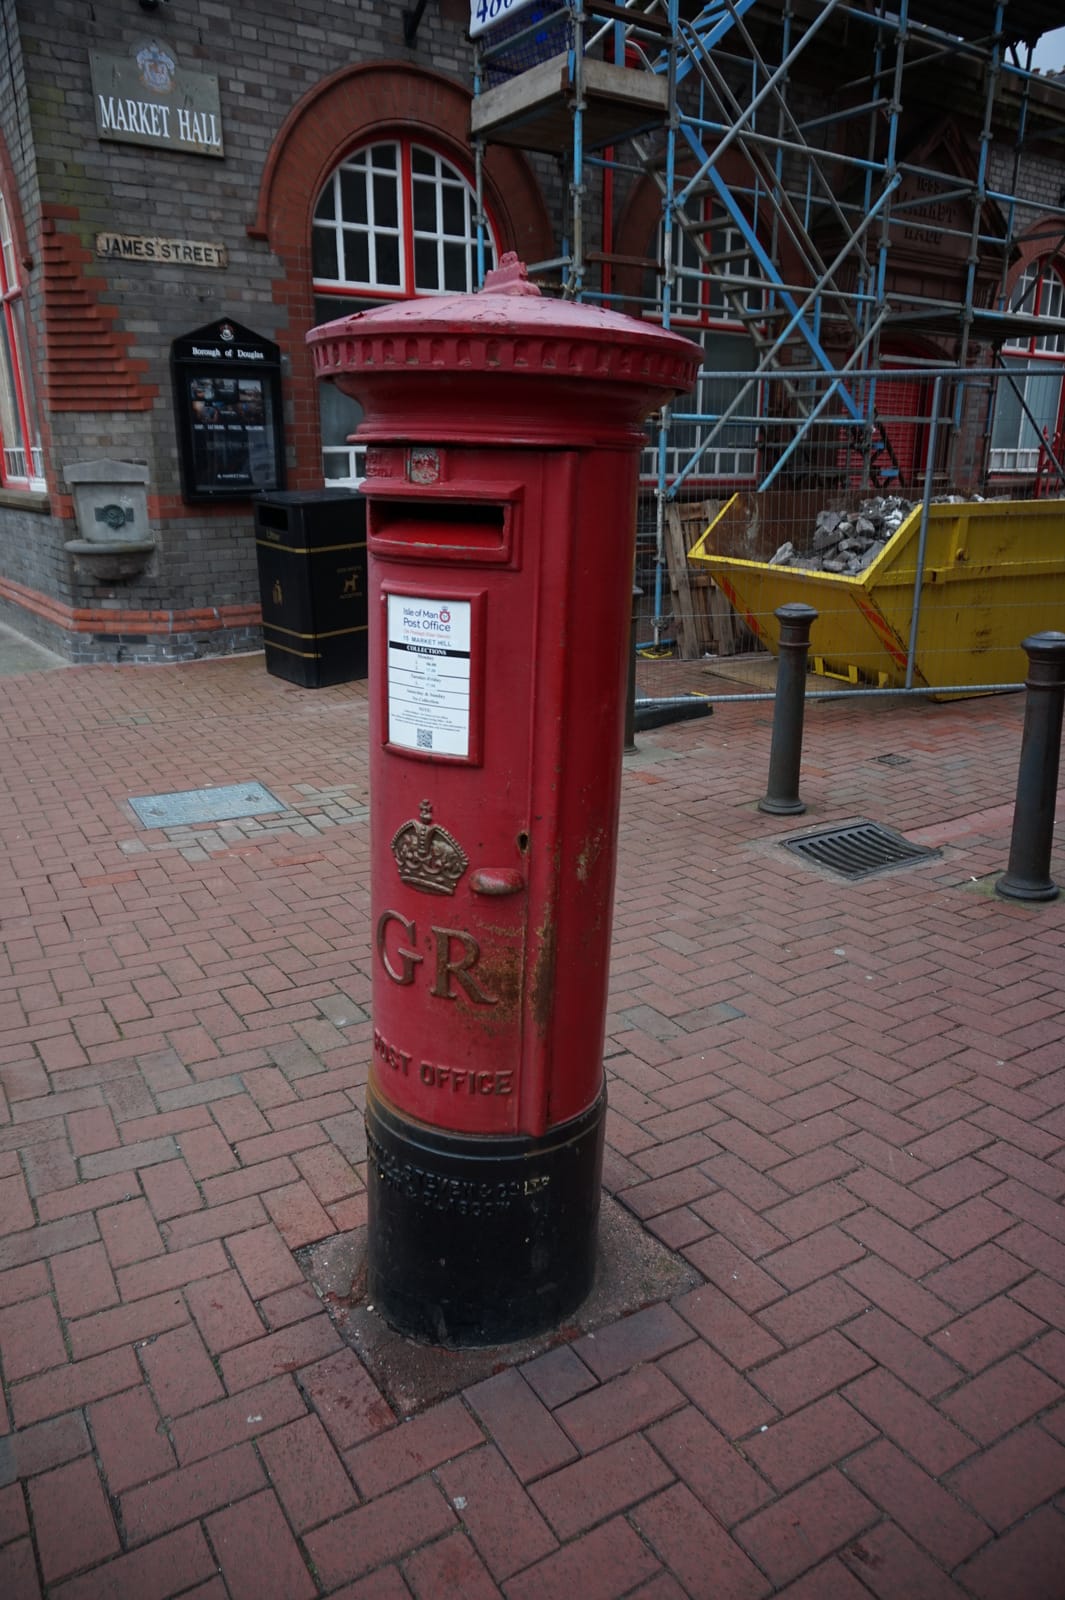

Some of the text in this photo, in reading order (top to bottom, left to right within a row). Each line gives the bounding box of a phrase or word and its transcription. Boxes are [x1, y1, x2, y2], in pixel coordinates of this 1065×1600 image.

[98, 94, 221, 147] MARKET HALL
[102, 237, 223, 264] JAMES STREET
[191, 346, 264, 360] Borough of Douglas
[402, 607, 438, 619] Isle of Man
[403, 617, 451, 632] Post Office
[406, 645, 448, 656] COLLECTIONS
[376, 909, 499, 1006] GR
[375, 1028, 514, 1097] POST OFFICE
